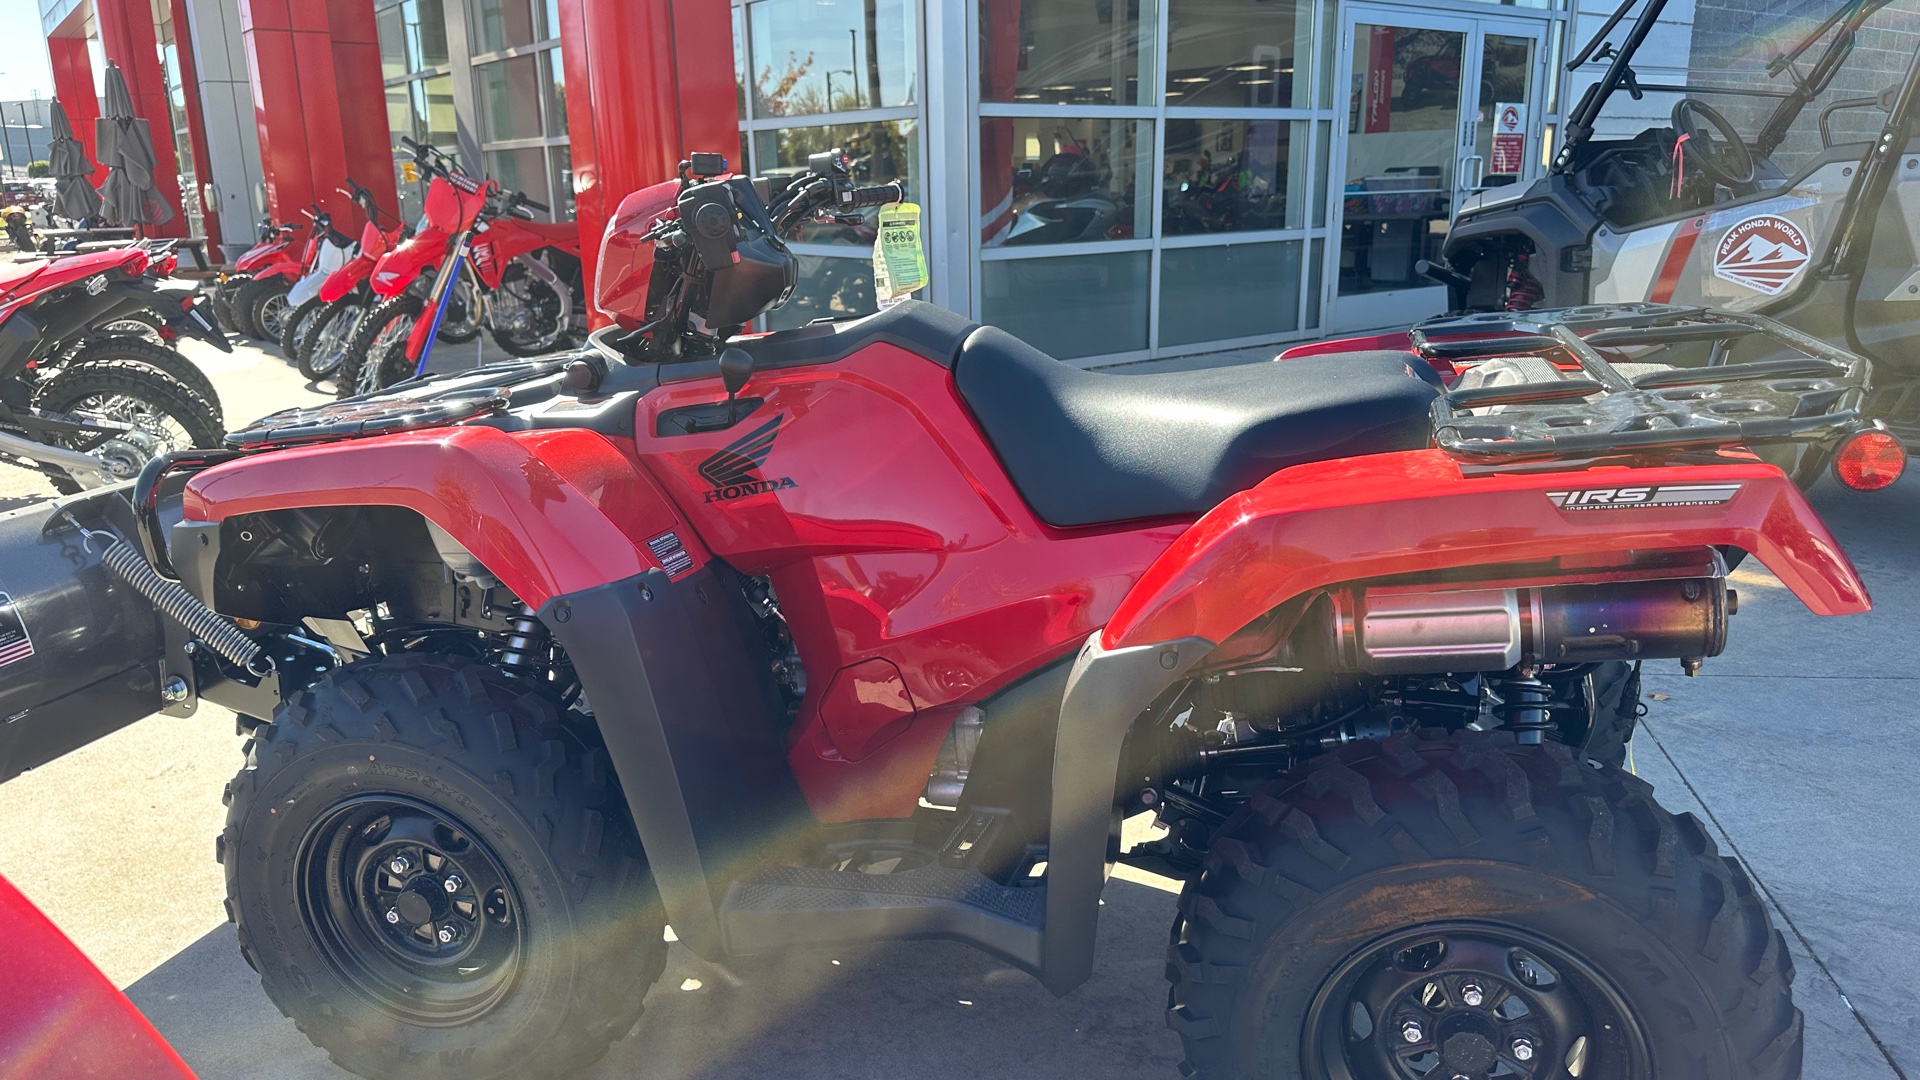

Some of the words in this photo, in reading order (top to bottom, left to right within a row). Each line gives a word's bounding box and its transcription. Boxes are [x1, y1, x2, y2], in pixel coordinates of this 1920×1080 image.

[1721, 232, 1739, 255] PEAK
[1738, 220, 1771, 234] HONDA
[1774, 221, 1801, 246] WORLD
[1717, 271, 1734, 279] POWER
[1734, 276, 1746, 284] YOUR
[1746, 281, 1773, 293] ADVENTURE
[703, 477, 799, 504] HONDA
[1566, 487, 1652, 504] IRS
